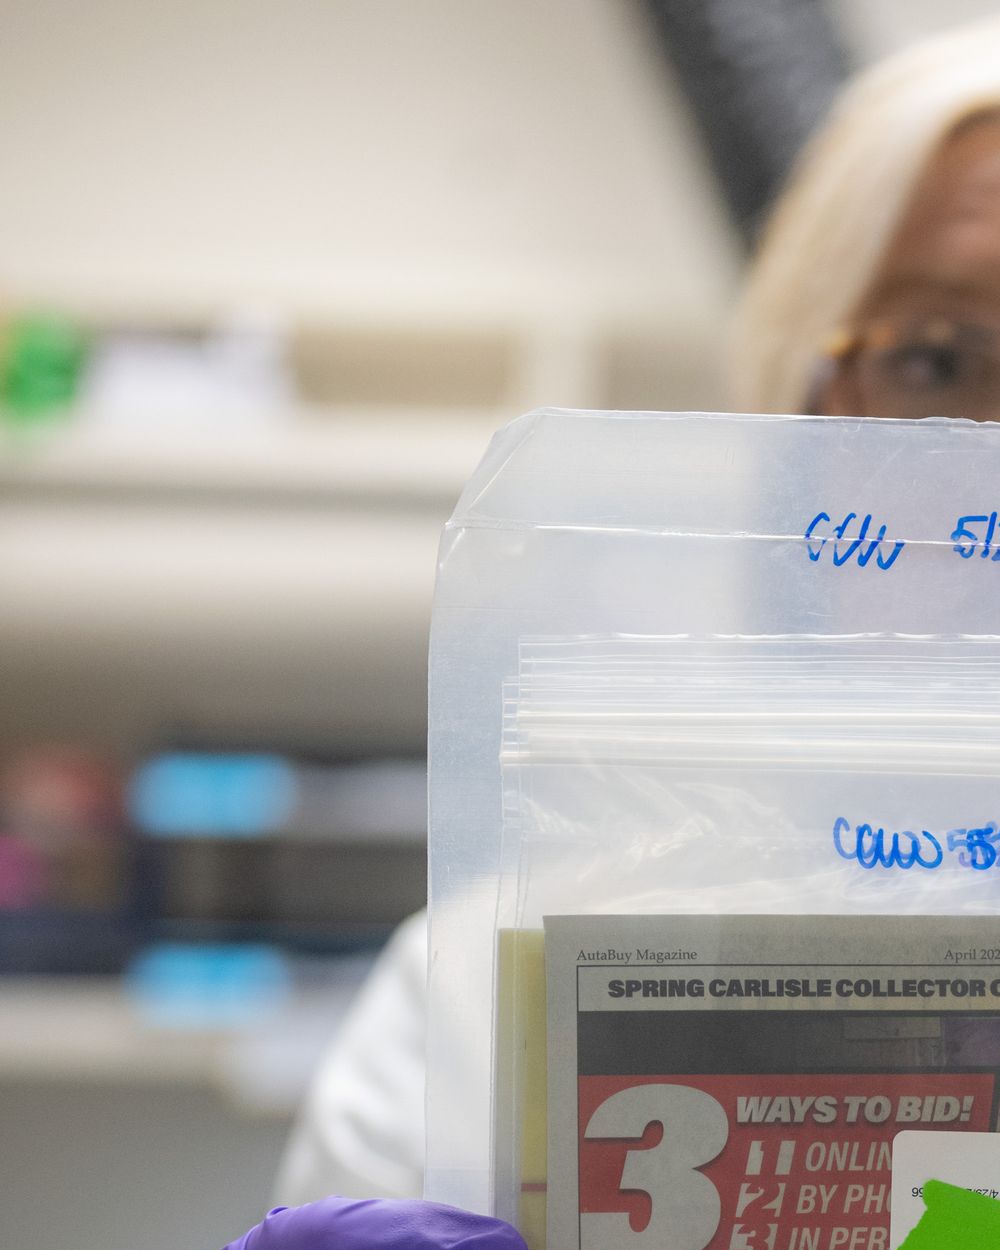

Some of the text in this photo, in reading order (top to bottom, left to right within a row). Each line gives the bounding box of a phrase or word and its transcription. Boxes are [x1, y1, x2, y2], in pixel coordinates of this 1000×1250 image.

[577, 949, 697, 963] AutaBuy Magazine
[944, 949, 977, 963] April
[608, 978, 704, 998] SPRING
[708, 978, 831, 998] CARLISLE
[835, 977, 986, 998] COLLECTOR
[736, 1095, 972, 1123] WAYS TO BID!
[796, 1184, 836, 1214] BY
